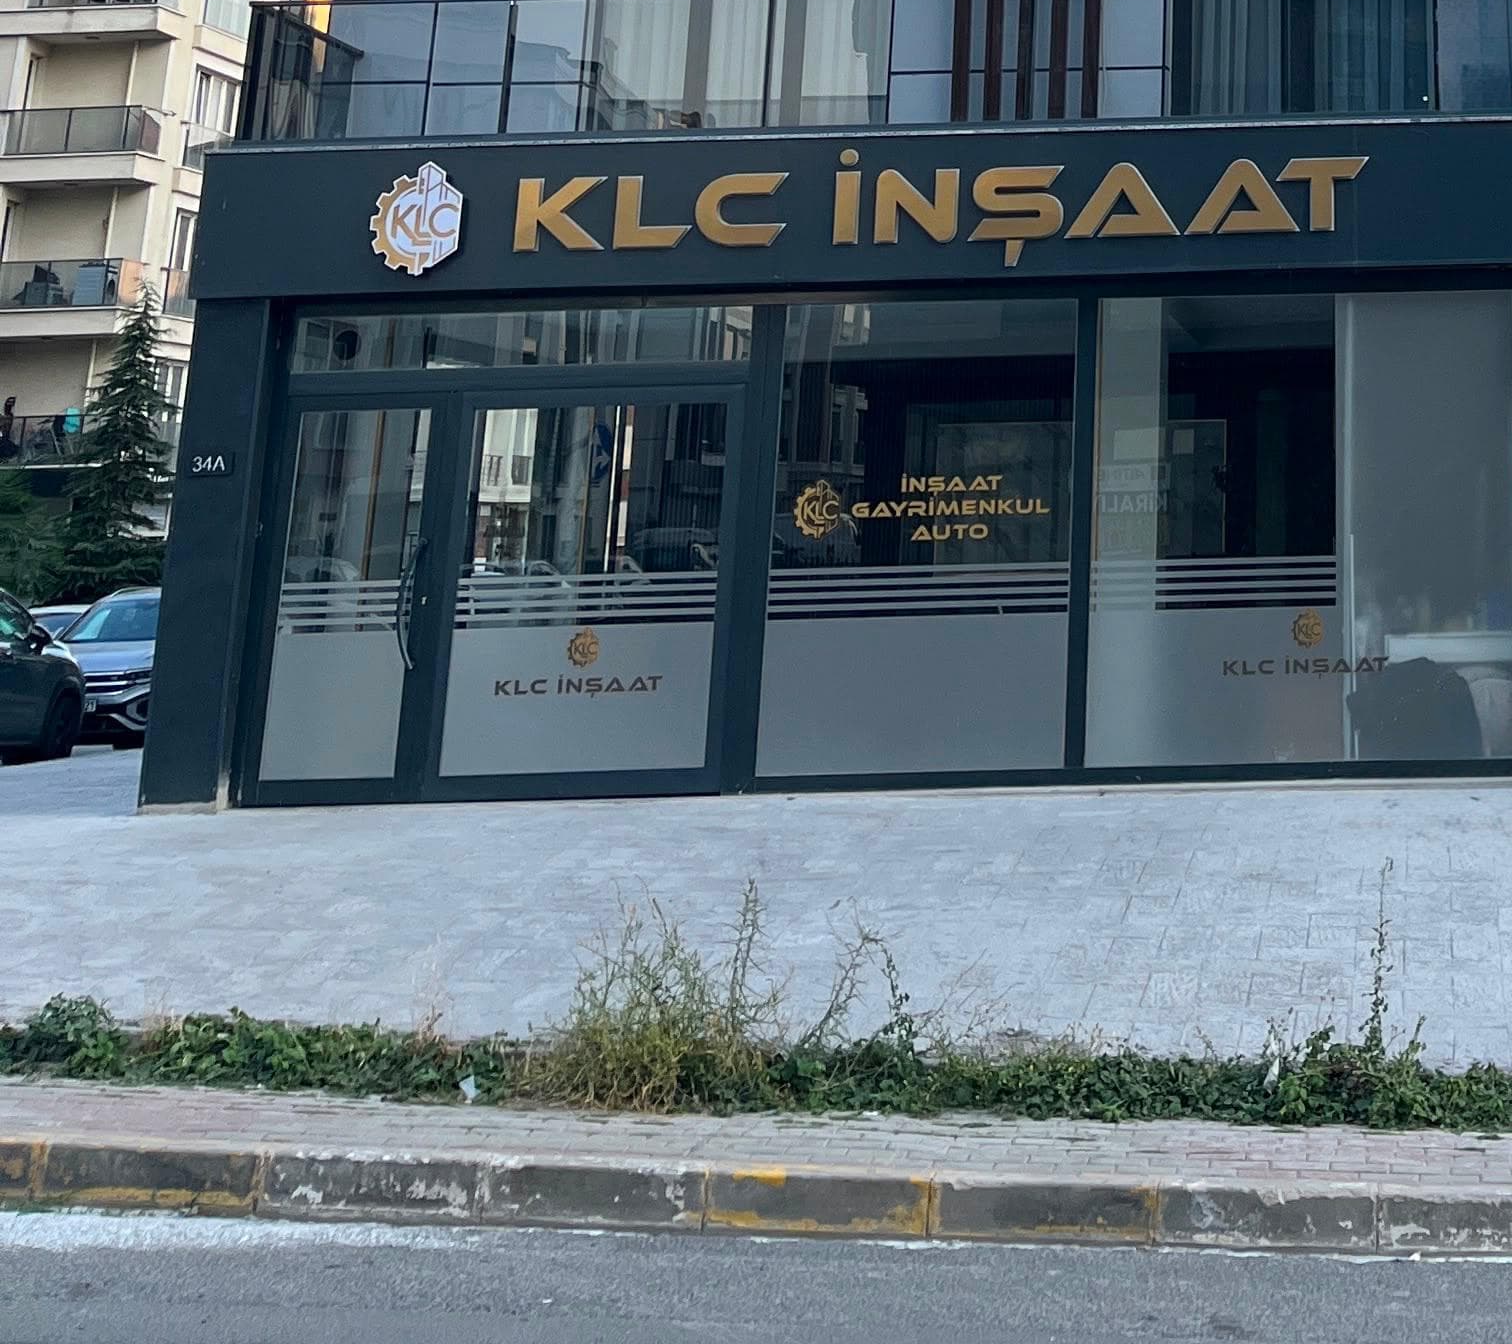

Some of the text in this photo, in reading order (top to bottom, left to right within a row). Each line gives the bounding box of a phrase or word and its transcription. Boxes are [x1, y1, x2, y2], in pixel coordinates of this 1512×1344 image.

[512, 148, 1370, 267] KLC İNŞAAT
[390, 202, 460, 247] KLC
[192, 455, 225, 472] 34A
[900, 473, 1004, 496] İNŞAAT
[802, 499, 840, 525] KLC
[851, 497, 1050, 519] GAYRİMENKUL
[910, 523, 989, 542] AUTO
[572, 640, 599, 658] KLC
[1222, 655, 1390, 680] KLC İNŞAAT
[494, 673, 663, 699] KLC İNŞAAT
